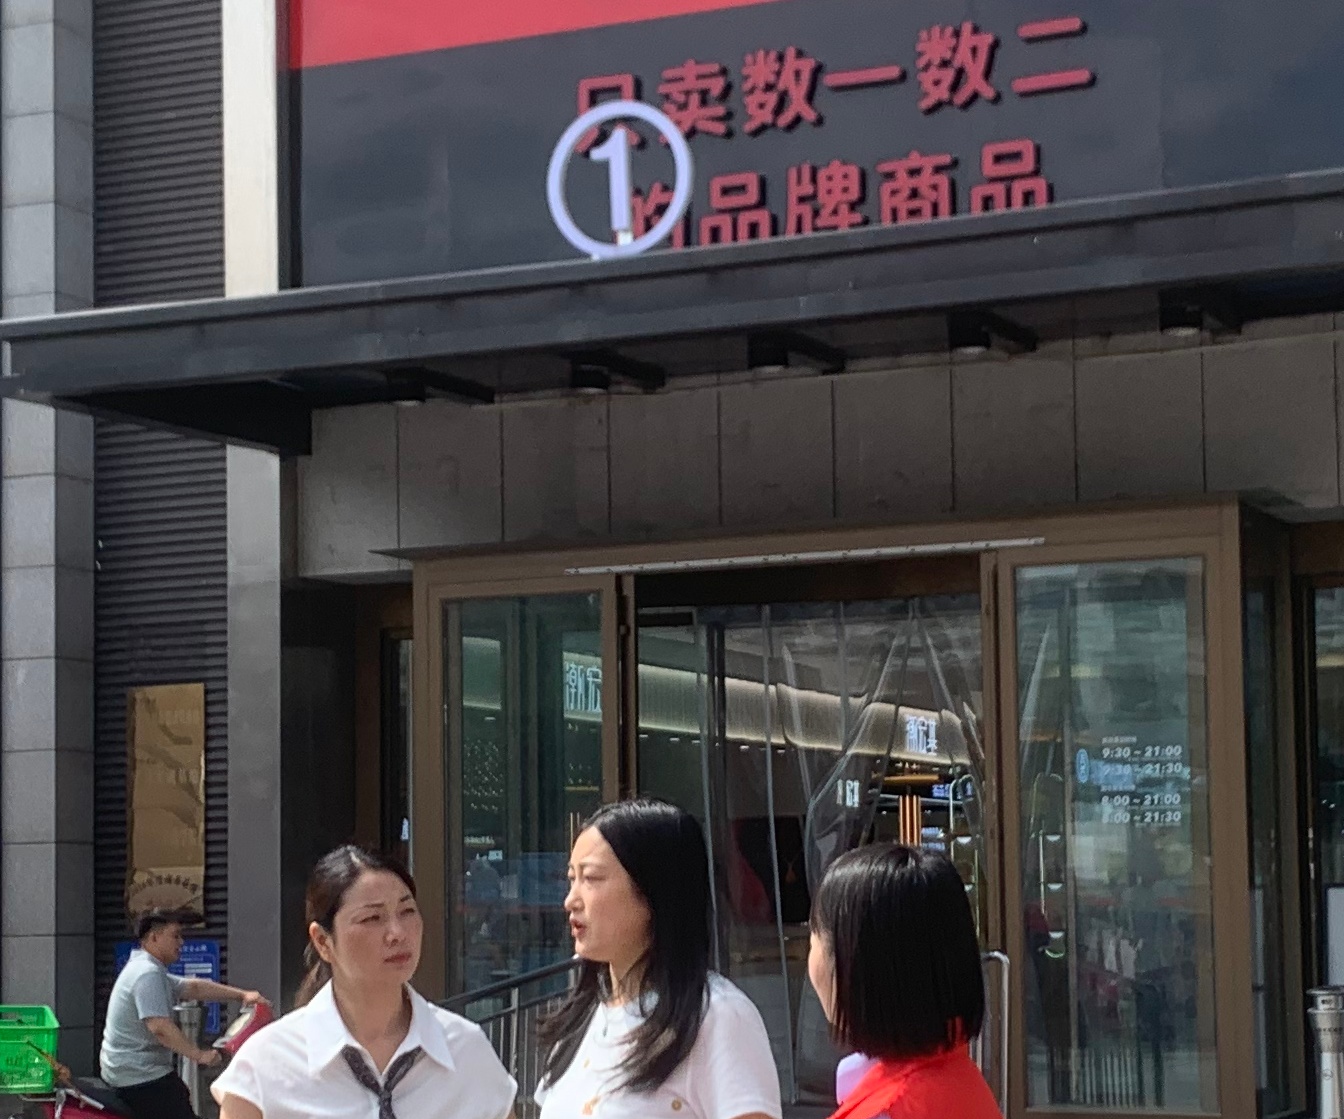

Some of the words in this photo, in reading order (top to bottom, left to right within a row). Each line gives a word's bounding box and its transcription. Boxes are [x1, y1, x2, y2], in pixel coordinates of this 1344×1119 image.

[575, 16, 1093, 154] 只卖数一数二
[1144, 745, 1183, 757] 21:00
[1144, 793, 1182, 805] 21:00
[1144, 811, 1182, 822] 21:30
